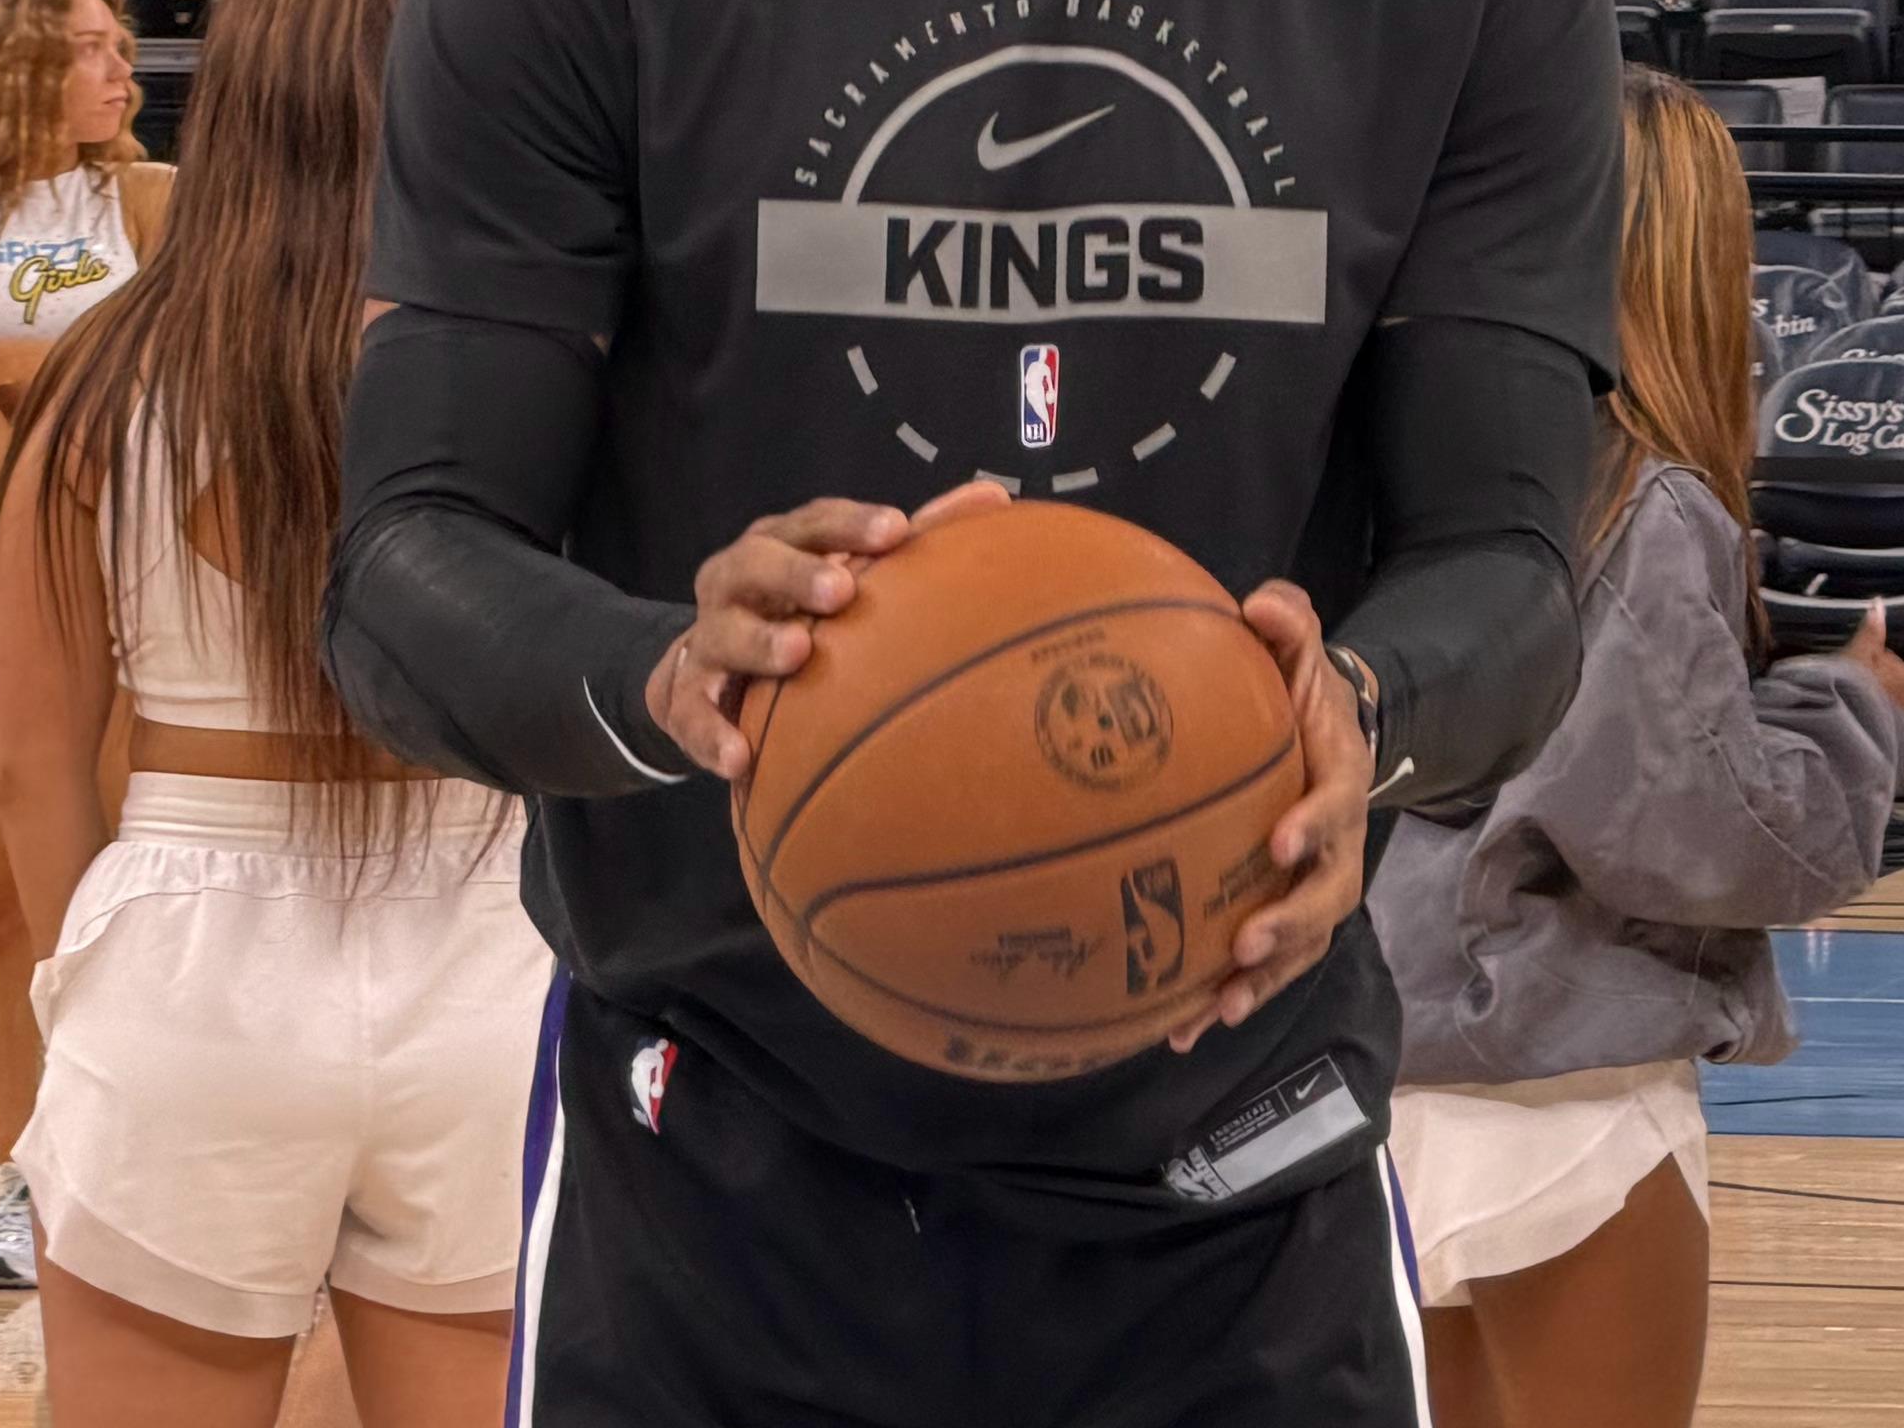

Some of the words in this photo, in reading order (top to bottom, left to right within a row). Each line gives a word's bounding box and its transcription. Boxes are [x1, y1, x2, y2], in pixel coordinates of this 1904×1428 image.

[9, 250, 110, 324] Girls
[884, 217, 1204, 311] KINGS
[1819, 422, 1872, 456] Log
